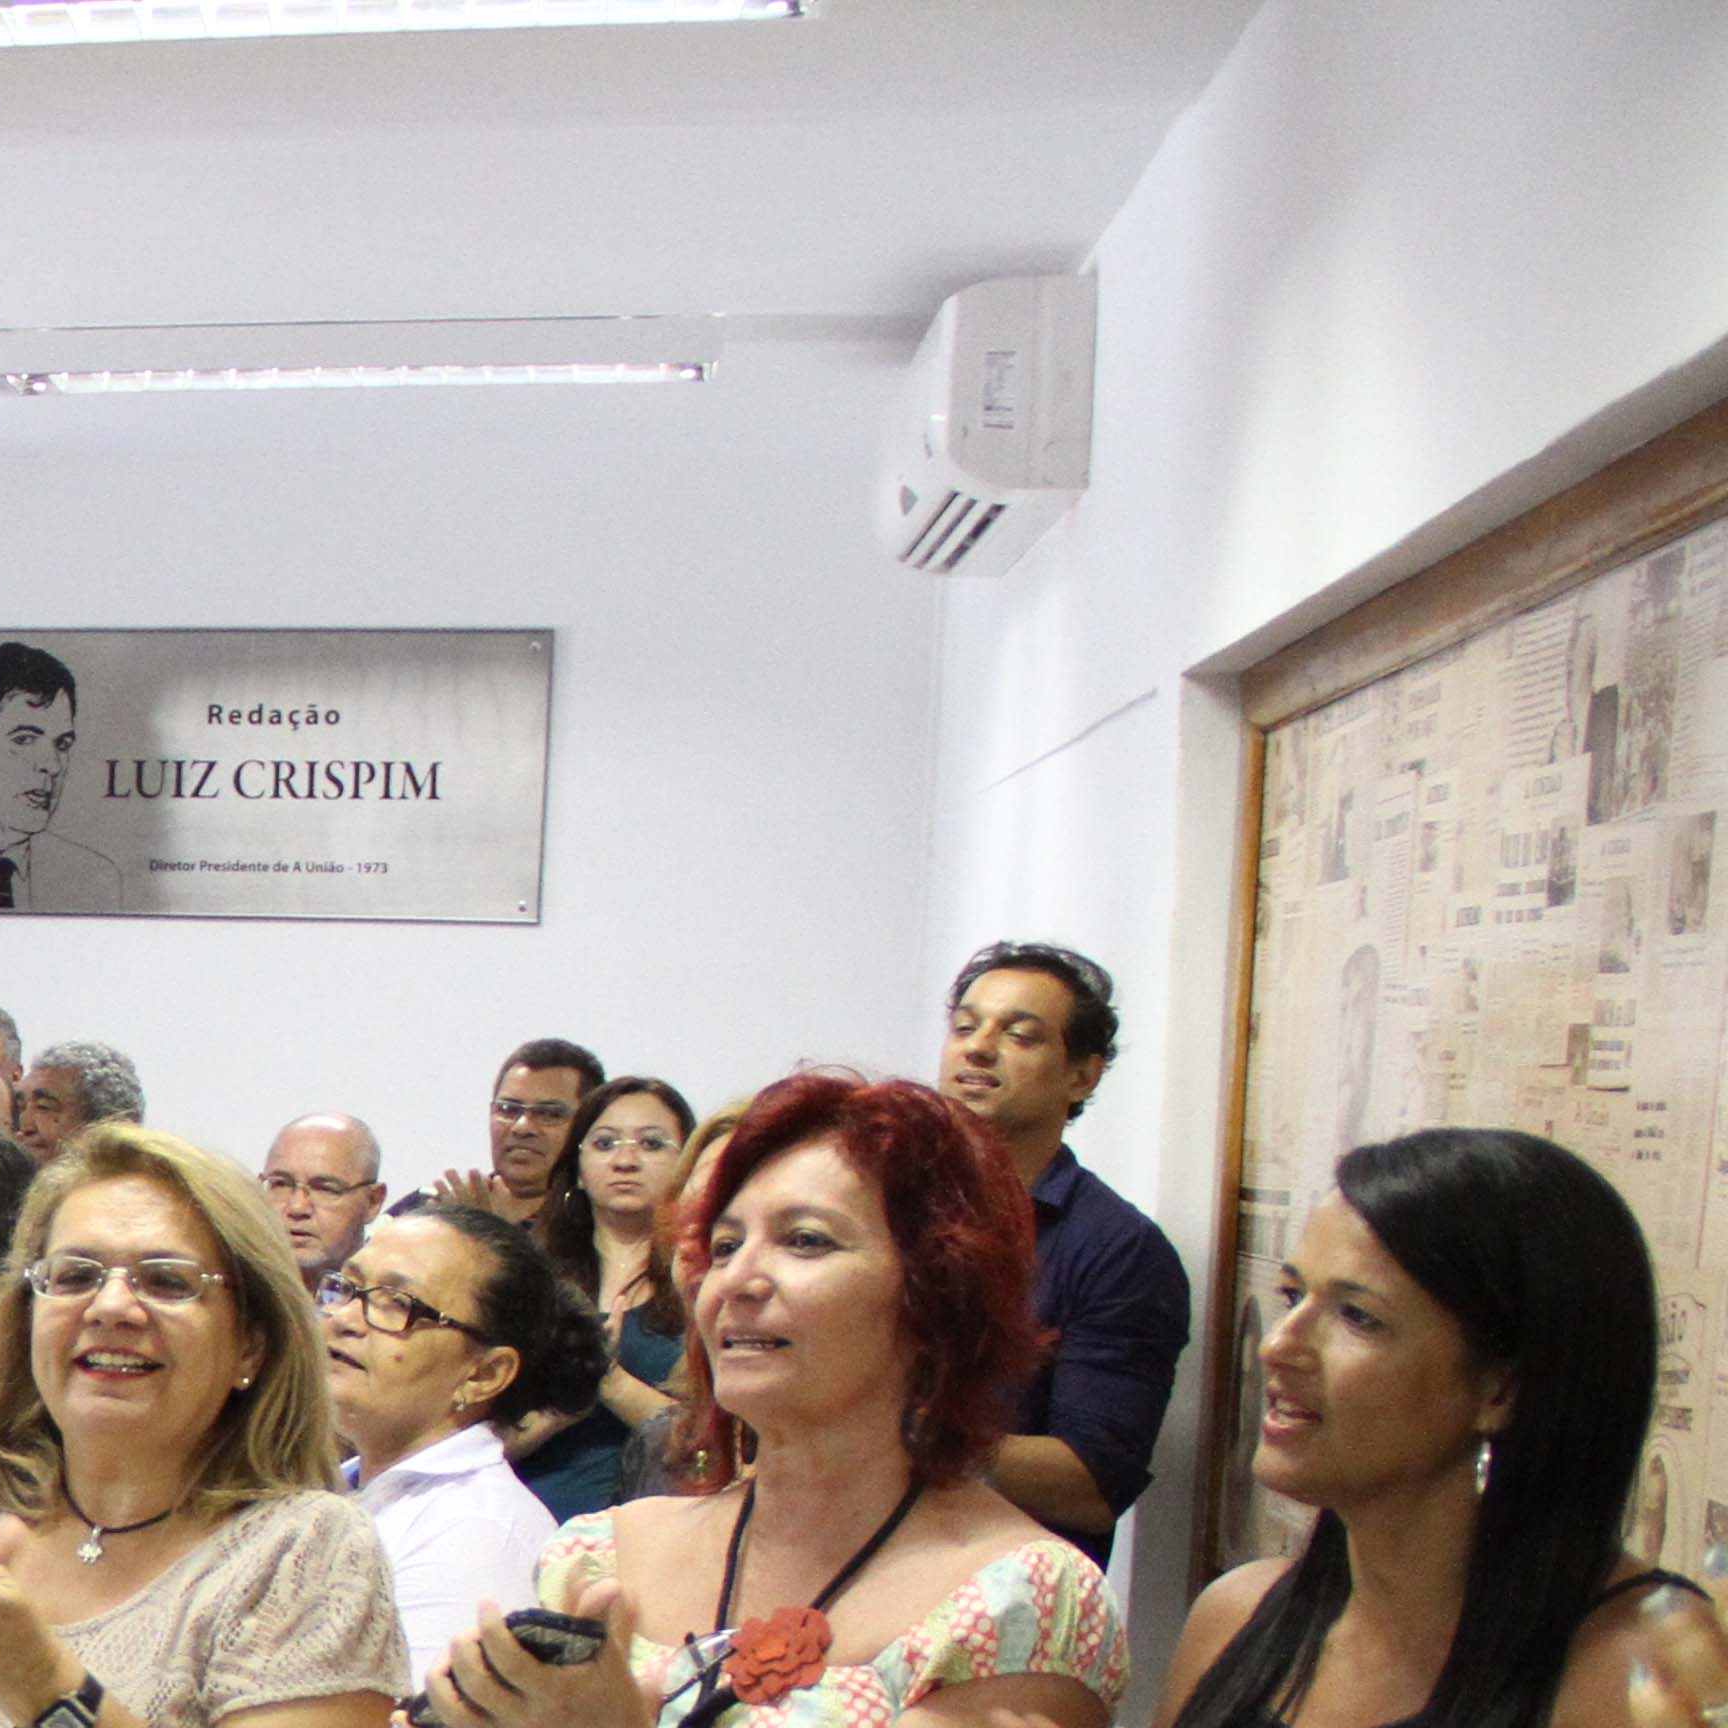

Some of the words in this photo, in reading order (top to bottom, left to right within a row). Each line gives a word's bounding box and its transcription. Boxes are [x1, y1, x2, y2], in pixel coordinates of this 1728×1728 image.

[206, 703, 341, 731] Redação
[103, 758, 220, 799] LUIZ
[233, 758, 442, 801] CRISPIM
[149, 858, 195, 872] Diretor
[199, 859, 269, 873] Presidente
[272, 860, 289, 873] de
[292, 860, 302, 873] A
[305, 860, 344, 874] União
[356, 861, 389, 874] 1973
